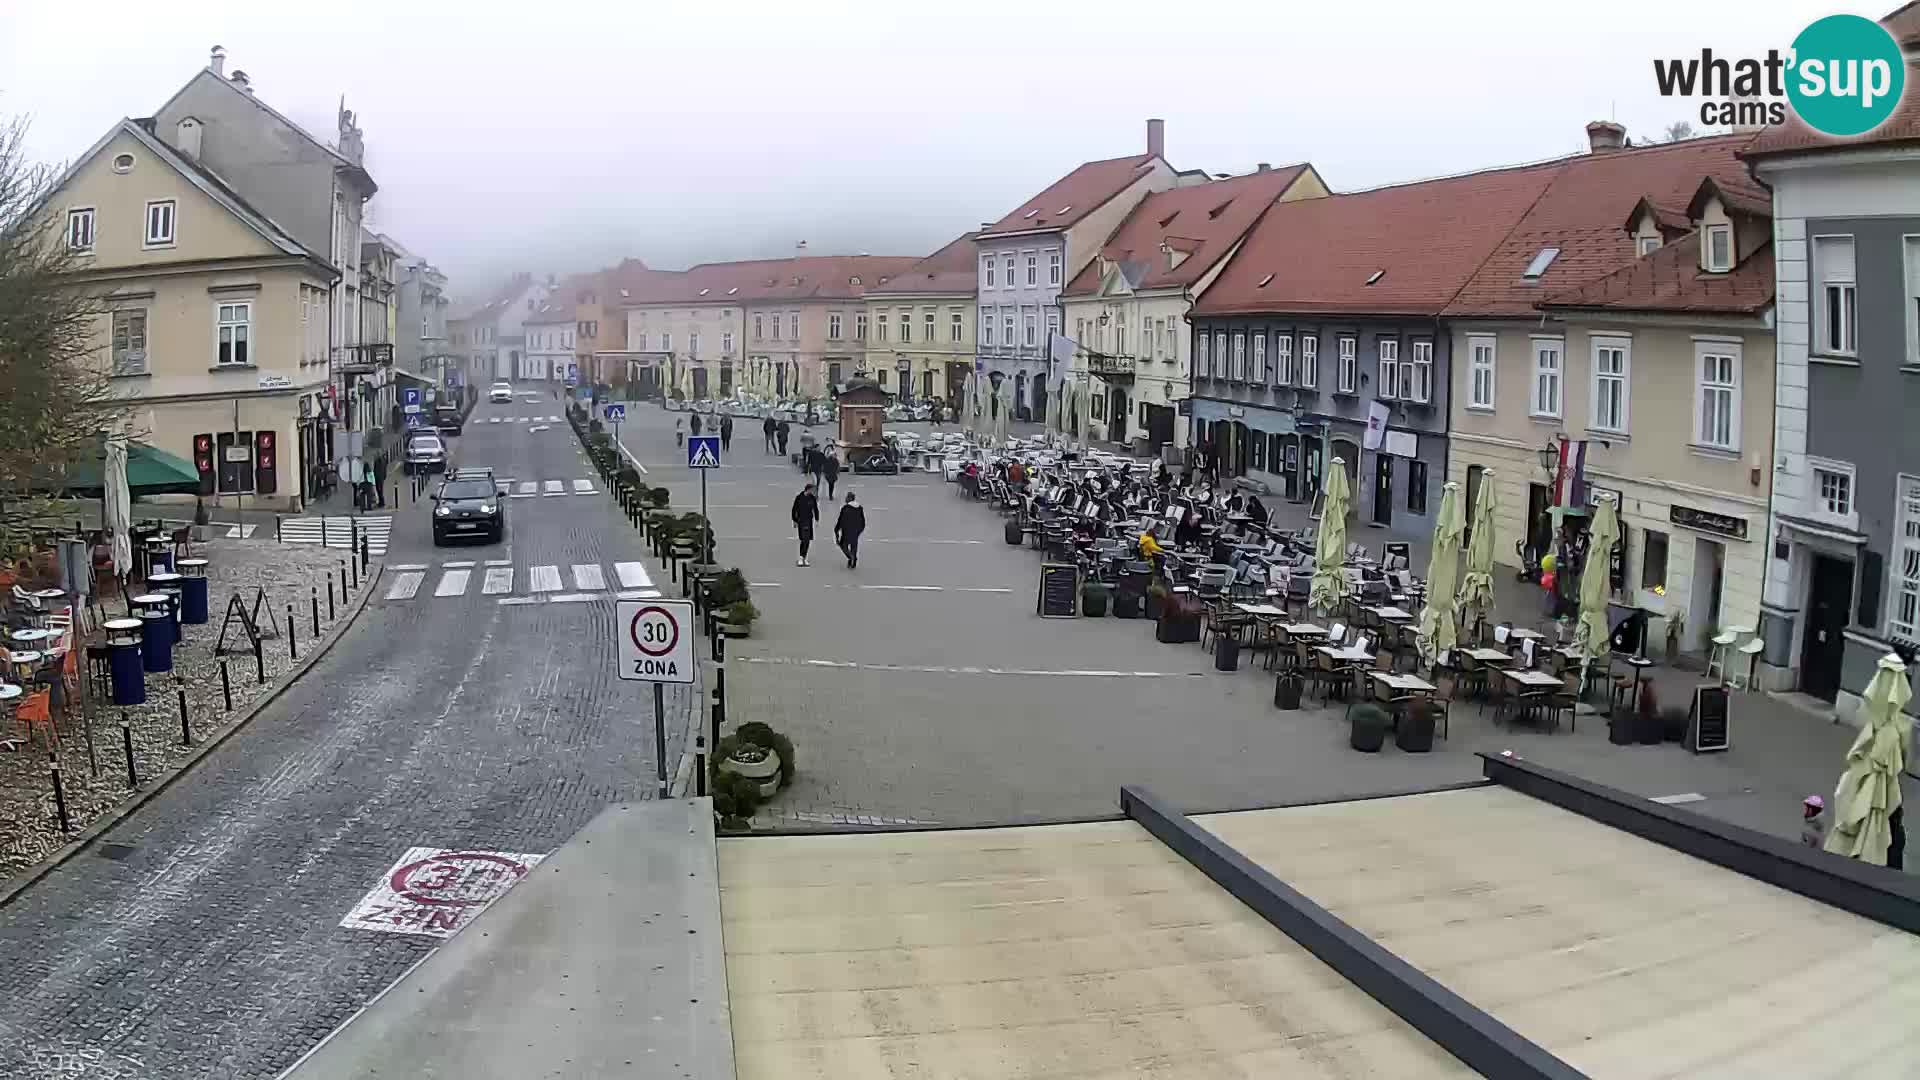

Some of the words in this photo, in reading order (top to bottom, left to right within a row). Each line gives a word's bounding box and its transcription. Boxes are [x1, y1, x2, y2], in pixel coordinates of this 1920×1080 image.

[408, 391, 416, 403] P
[643, 622, 667, 643] 30
[633, 659, 678, 676] ZONA
